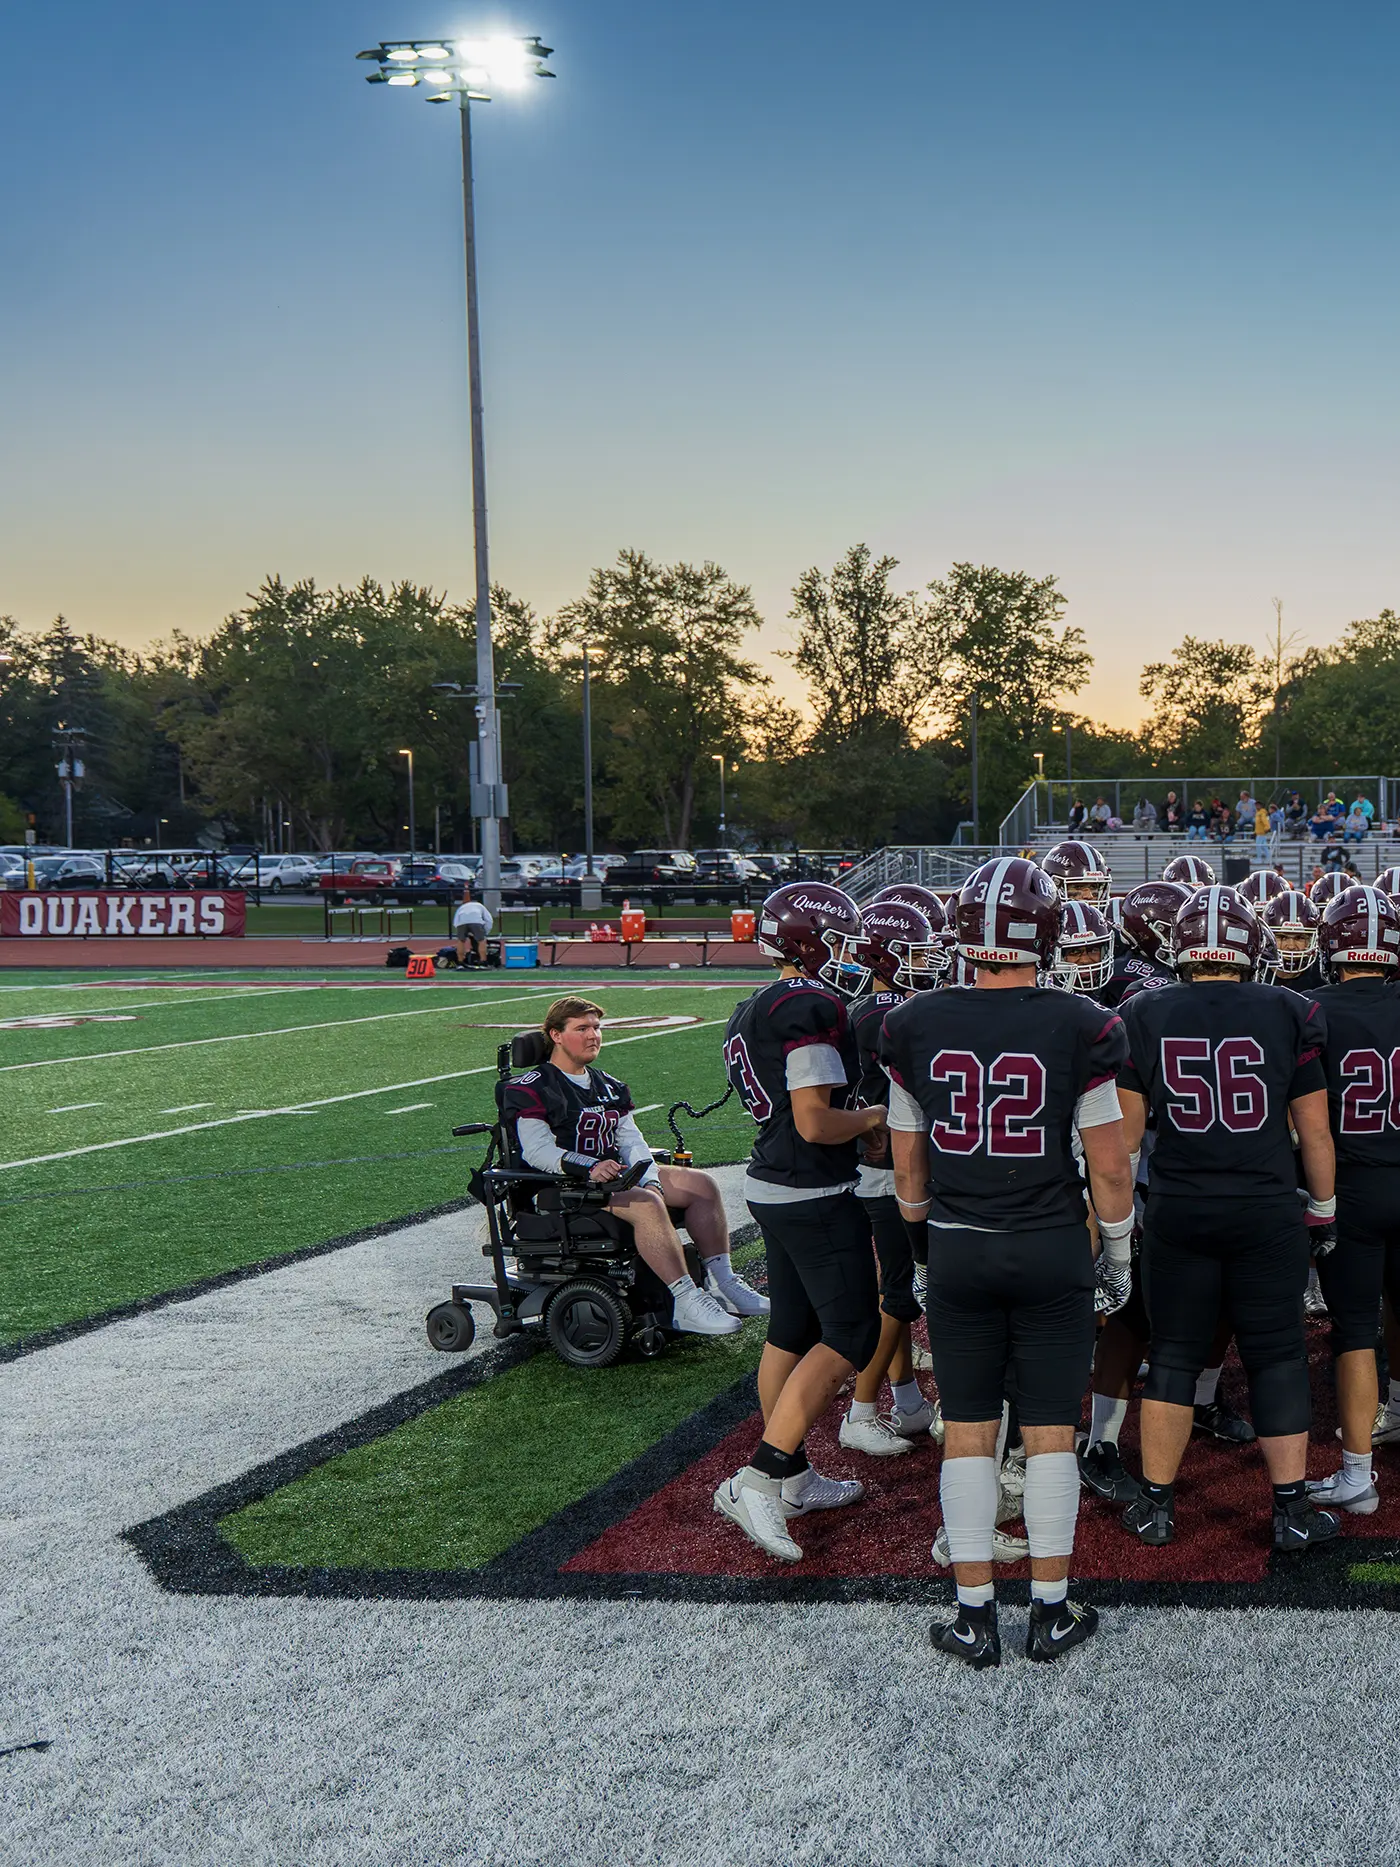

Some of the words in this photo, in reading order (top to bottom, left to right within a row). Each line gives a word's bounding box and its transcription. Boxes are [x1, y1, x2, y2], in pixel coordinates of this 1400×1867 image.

[974, 881, 1015, 904] 32
[793, 895, 849, 919] Quakers
[1198, 895, 1231, 911] 56
[1356, 897, 1388, 915] 26
[19, 896, 225, 935] QUAKERS
[864, 912, 911, 929] Quakers
[1073, 932, 1094, 940] Riddell
[966, 947, 1018, 961] Riddell
[1189, 950, 1235, 961] Riddell
[1347, 951, 1391, 963] Riddell
[408, 959, 428, 975] 30
[1124, 959, 1155, 977] 52
[605, 1084, 620, 1100] C
[1161, 1036, 1268, 1133] 56
[930, 1049, 1047, 1157] 32
[575, 1110, 620, 1156] 80
